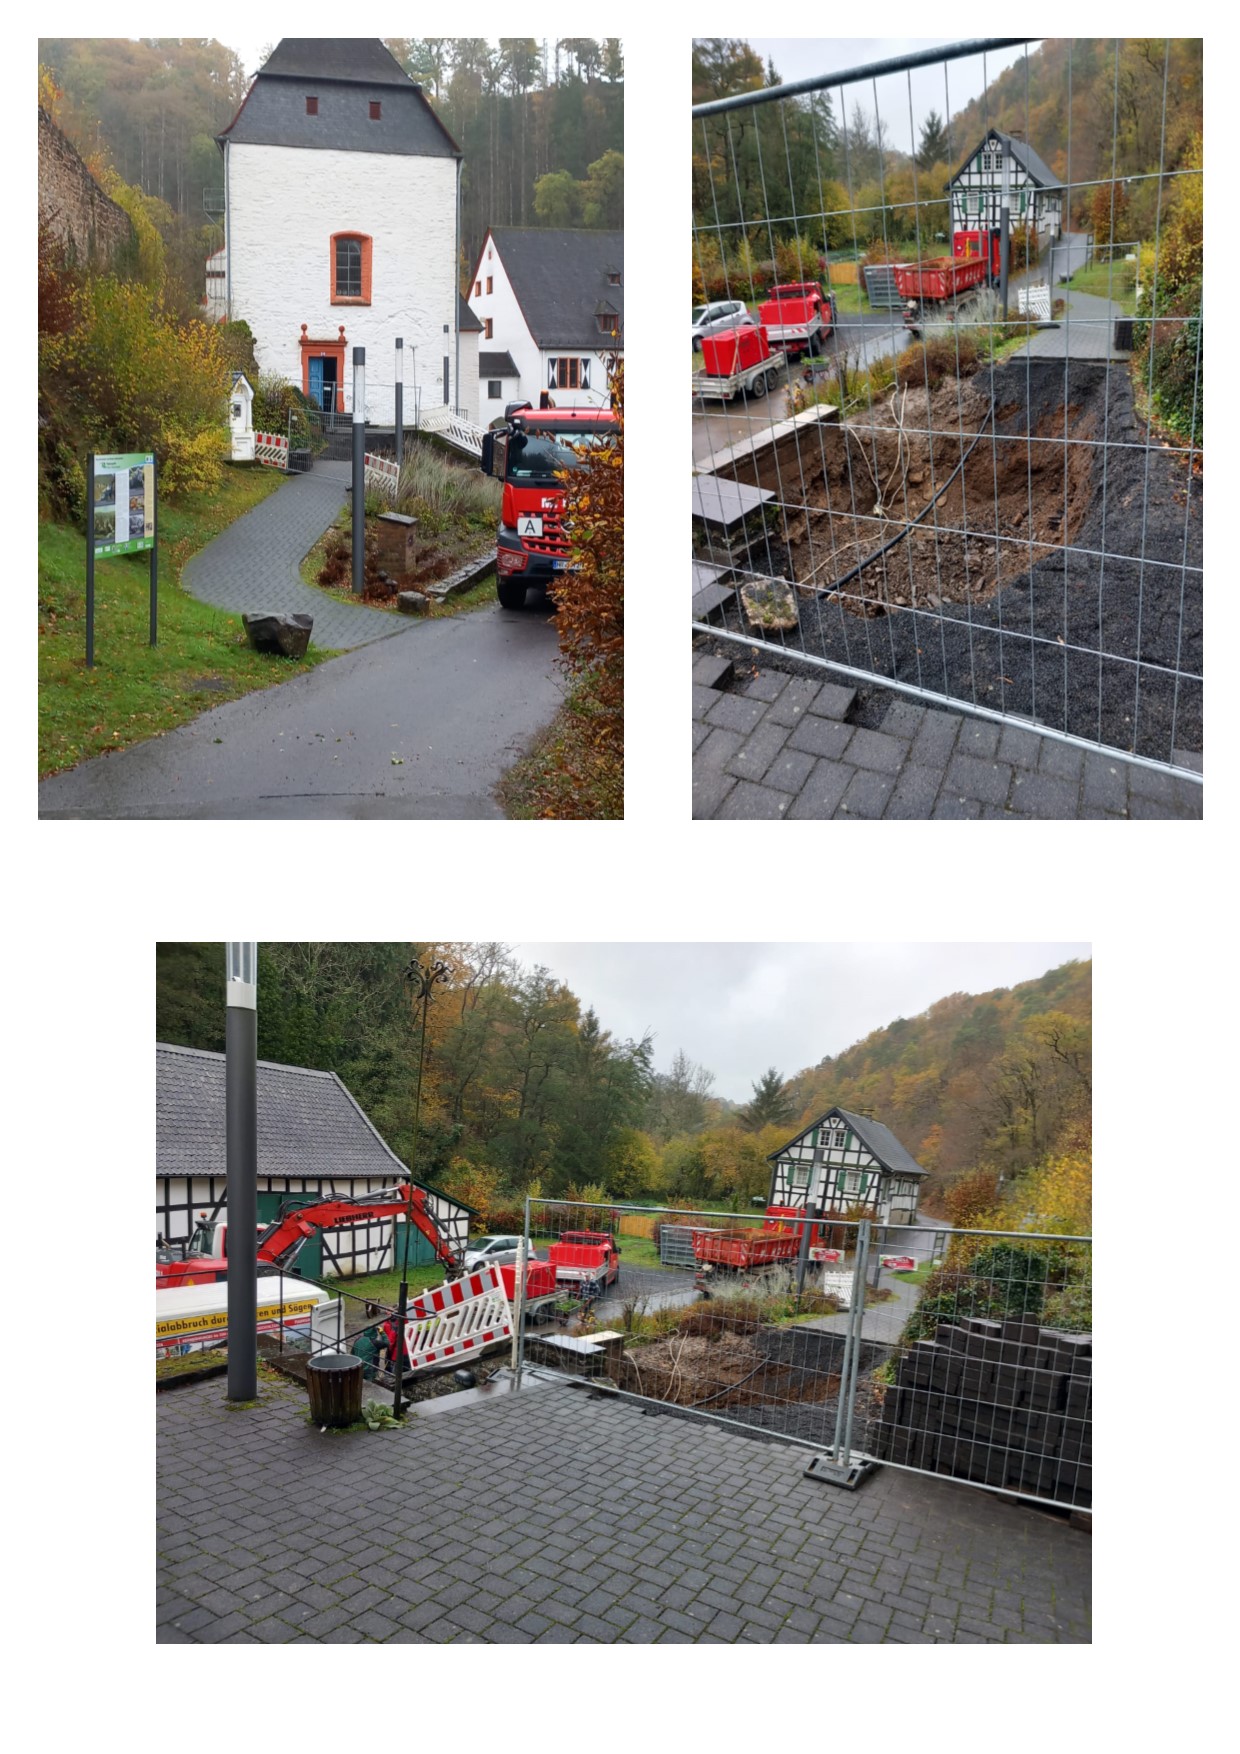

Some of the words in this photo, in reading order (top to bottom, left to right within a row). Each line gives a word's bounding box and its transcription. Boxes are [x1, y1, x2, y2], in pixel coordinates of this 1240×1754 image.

[524, 519, 536, 534] A
[334, 1211, 374, 1224] LIEBHERR
[256, 1310, 269, 1318] en
[271, 1305, 286, 1314] und
[288, 1303, 312, 1313] Sägen
